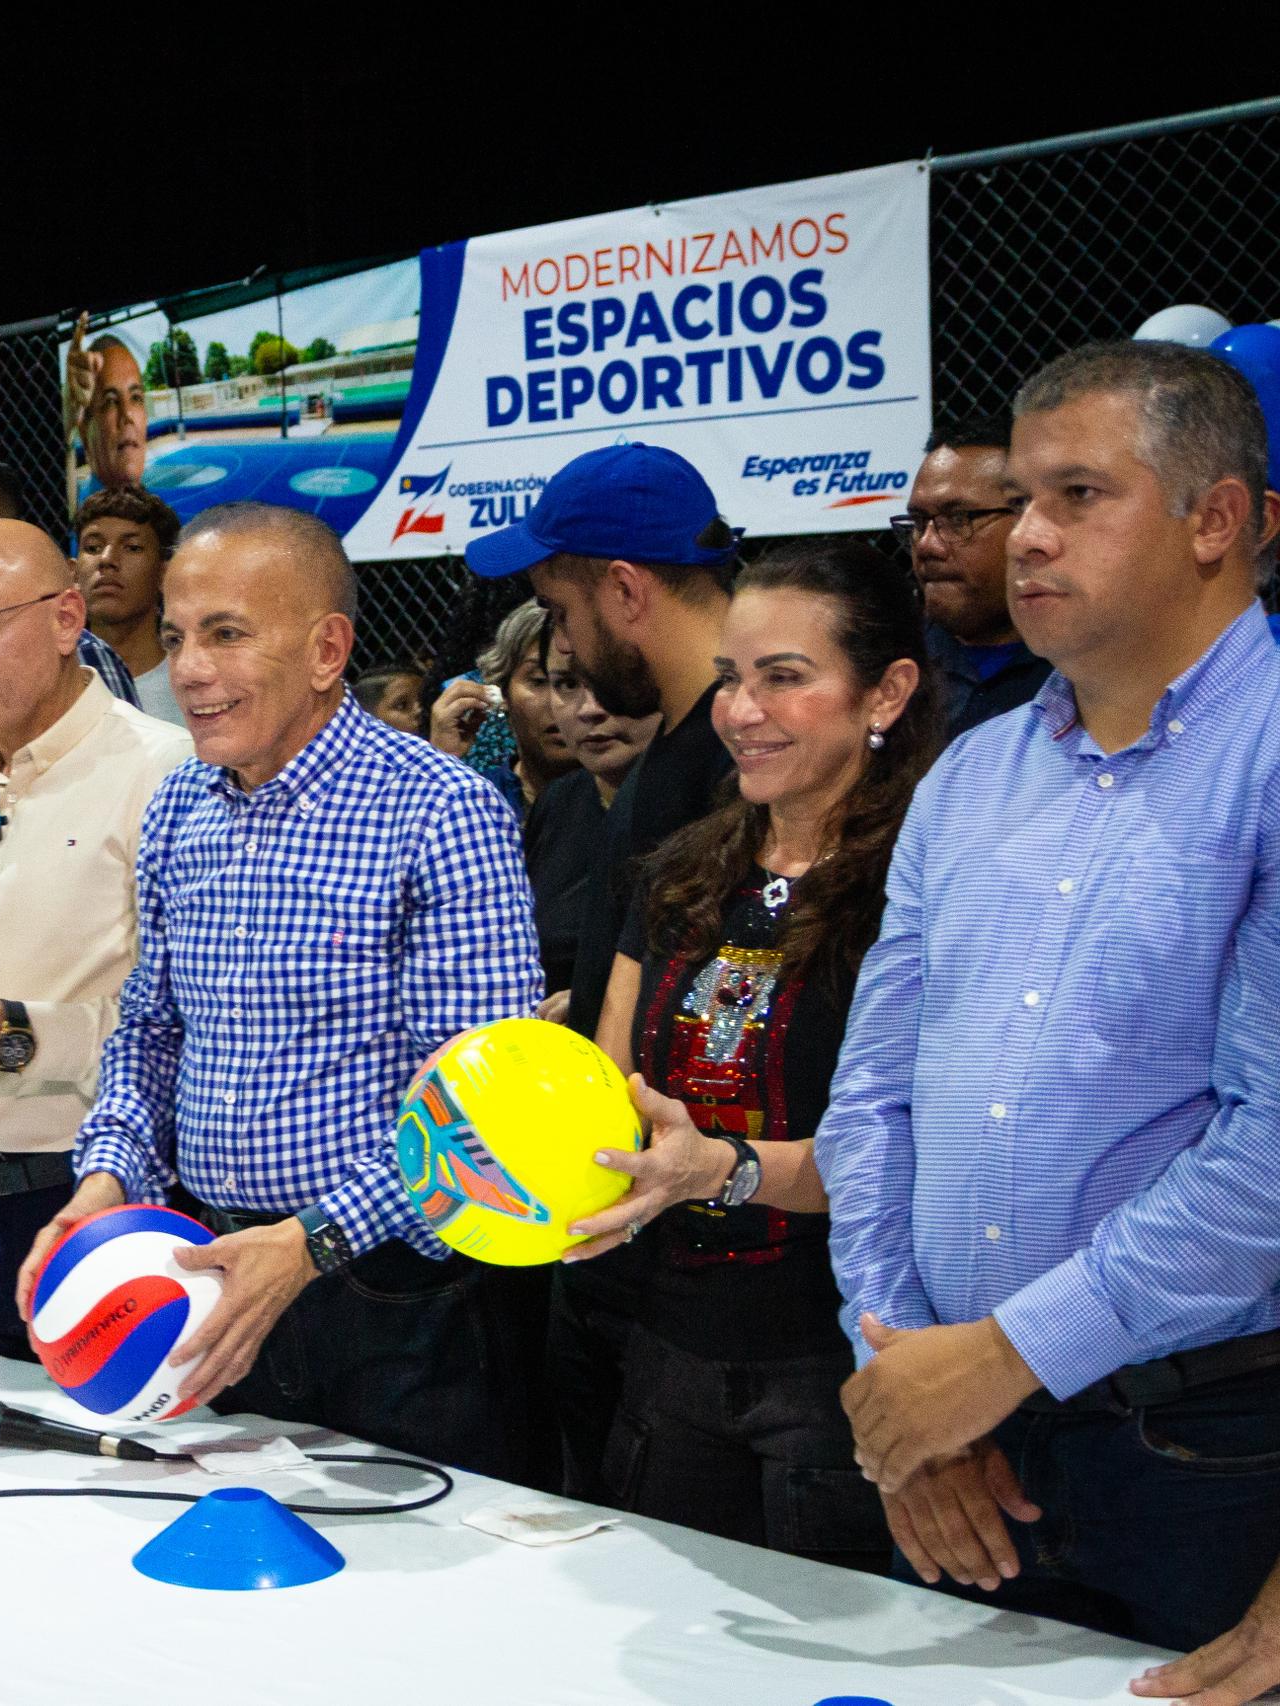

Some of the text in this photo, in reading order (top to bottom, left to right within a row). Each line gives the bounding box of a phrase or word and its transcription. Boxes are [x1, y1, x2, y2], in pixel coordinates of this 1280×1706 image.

[500, 213, 850, 301] MODERNIZAMOS
[524, 268, 827, 361] ESPACIOS
[486, 330, 885, 427] DEPORTIVOS
[742, 451, 871, 481] Esperanza
[793, 470, 908, 496] es Futuro
[470, 494, 533, 528] ZULI
